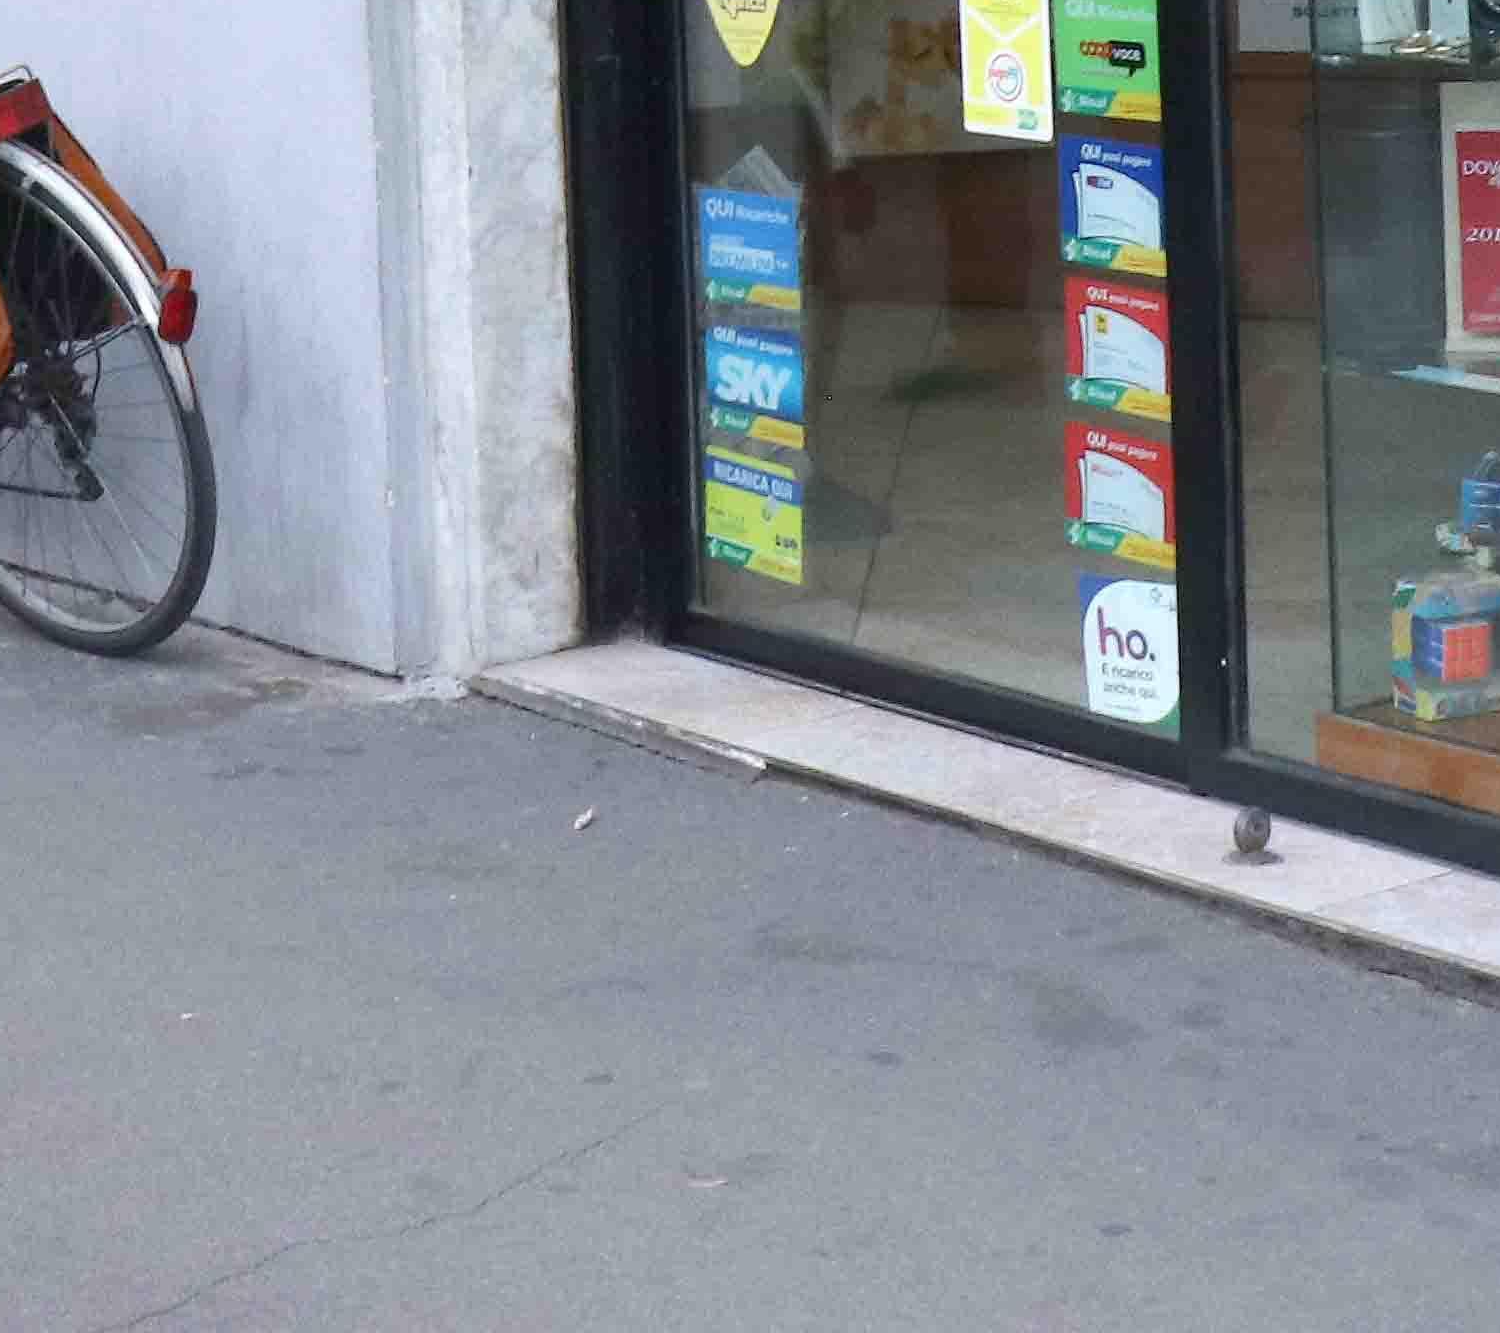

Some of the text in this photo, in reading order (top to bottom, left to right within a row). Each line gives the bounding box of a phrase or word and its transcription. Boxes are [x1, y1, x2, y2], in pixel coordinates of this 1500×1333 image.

[1080, 142, 1102, 160] QUI
[704, 196, 735, 220] QUI
[1087, 285, 1109, 302] QUI
[713, 325, 736, 343] QUI
[713, 353, 794, 412] SKY
[1086, 429, 1108, 448] QUI
